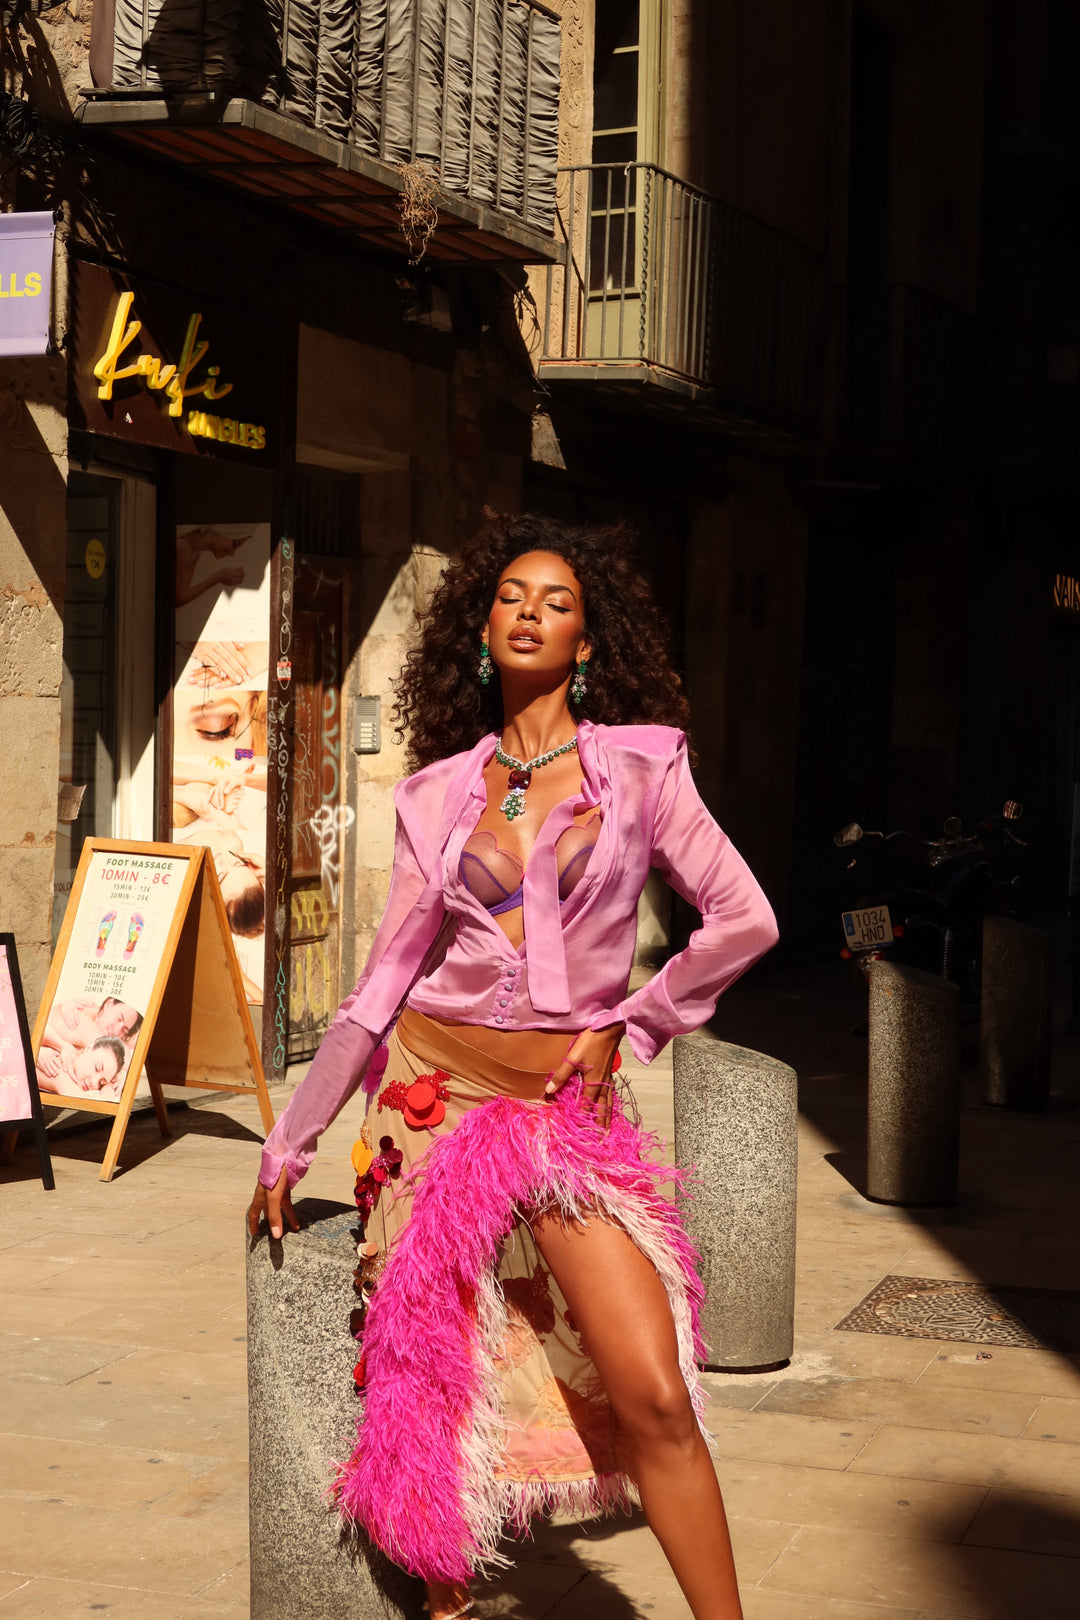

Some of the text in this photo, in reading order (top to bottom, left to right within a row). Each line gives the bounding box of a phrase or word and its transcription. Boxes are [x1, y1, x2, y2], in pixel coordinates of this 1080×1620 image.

[106, 858, 173, 870] FOOT MASSAGE
[101, 868, 140, 882] 10MIN
[152, 873, 172, 885] 8€
[113, 883, 132, 891] 15MIN
[110, 892, 130, 900] 30MIN
[856, 909, 886, 928] 1034
[861, 925, 885, 943] HND
[103, 964, 137, 973] MASSAGE
[88, 971, 107, 979] 10MIN
[84, 985, 103, 993] 30MIN
